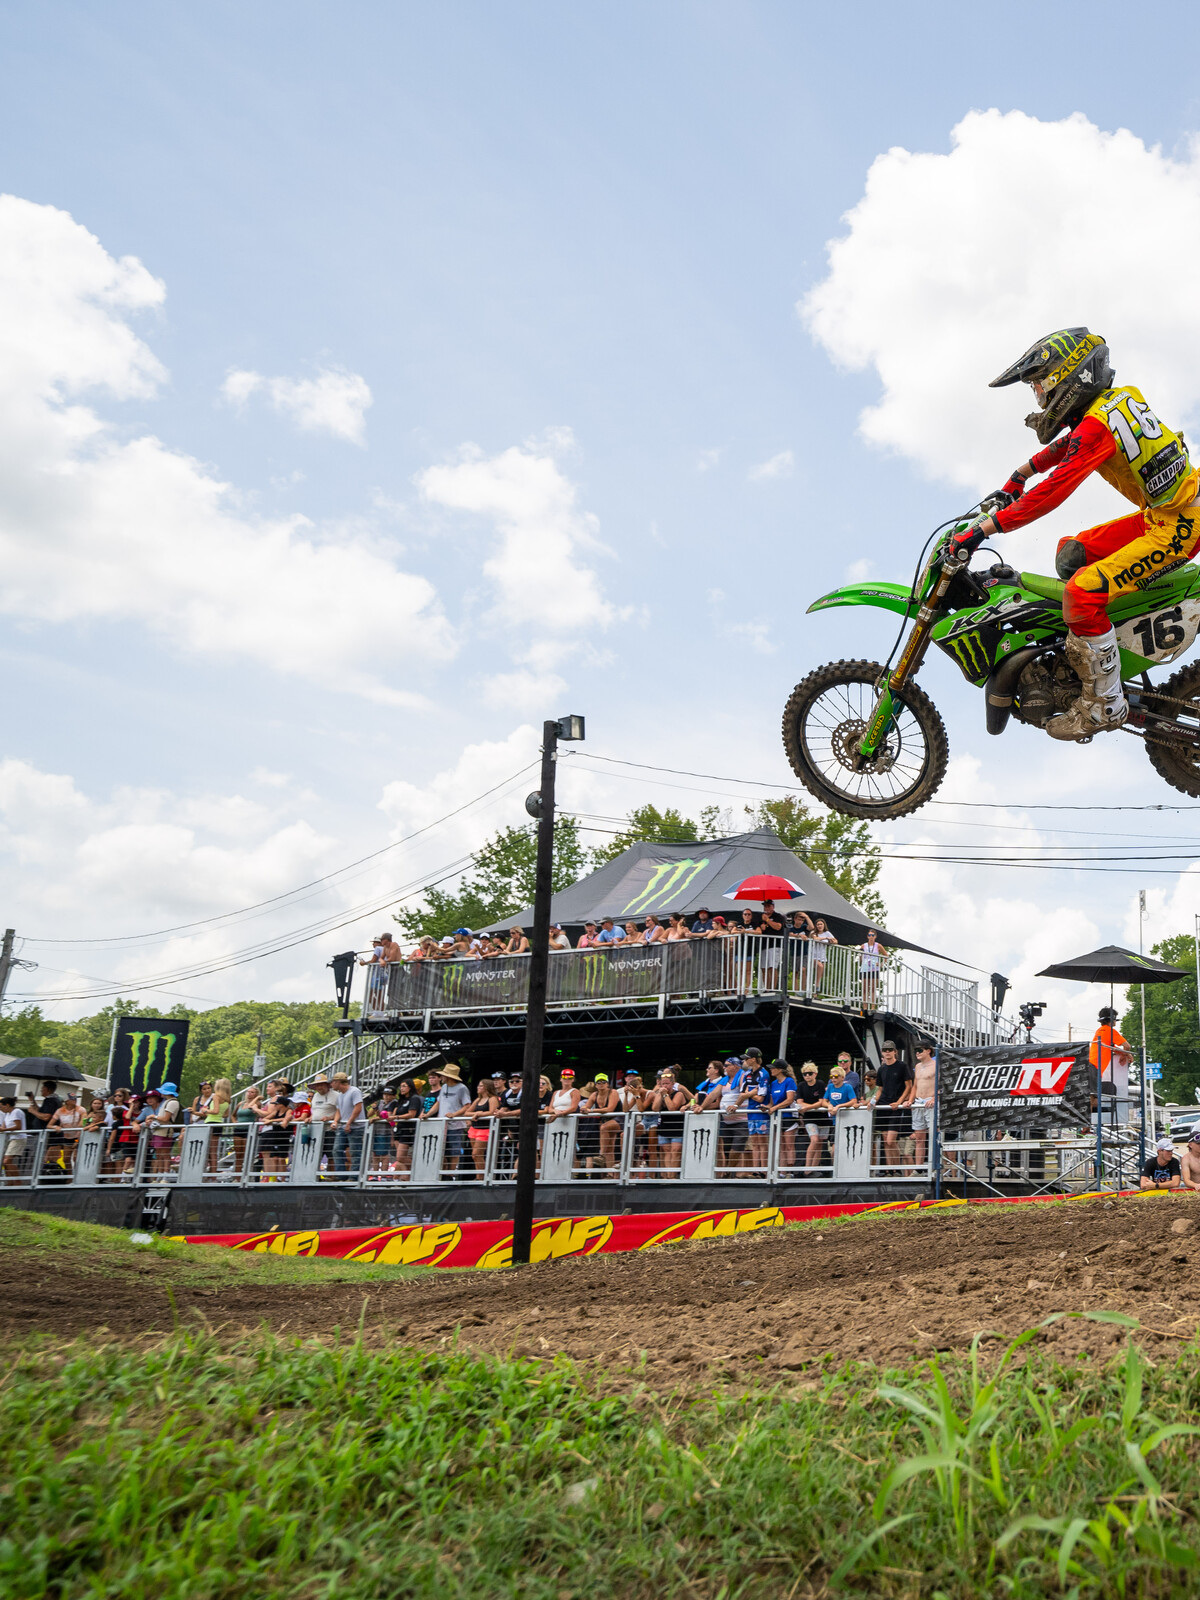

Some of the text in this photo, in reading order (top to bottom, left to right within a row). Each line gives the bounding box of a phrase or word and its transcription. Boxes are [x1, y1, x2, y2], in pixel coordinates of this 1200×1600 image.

[1107, 396, 1163, 464] 16
[879, 592, 908, 602] CIRCUI
[947, 595, 1014, 636] KX
[1133, 606, 1185, 656] 16
[1100, 649, 1117, 667] FOX
[608, 957, 662, 972] MONSTER
[465, 969, 516, 983] MONSTER
[967, 1096, 1063, 1108] ALL RACING! ALL THE TIME!
